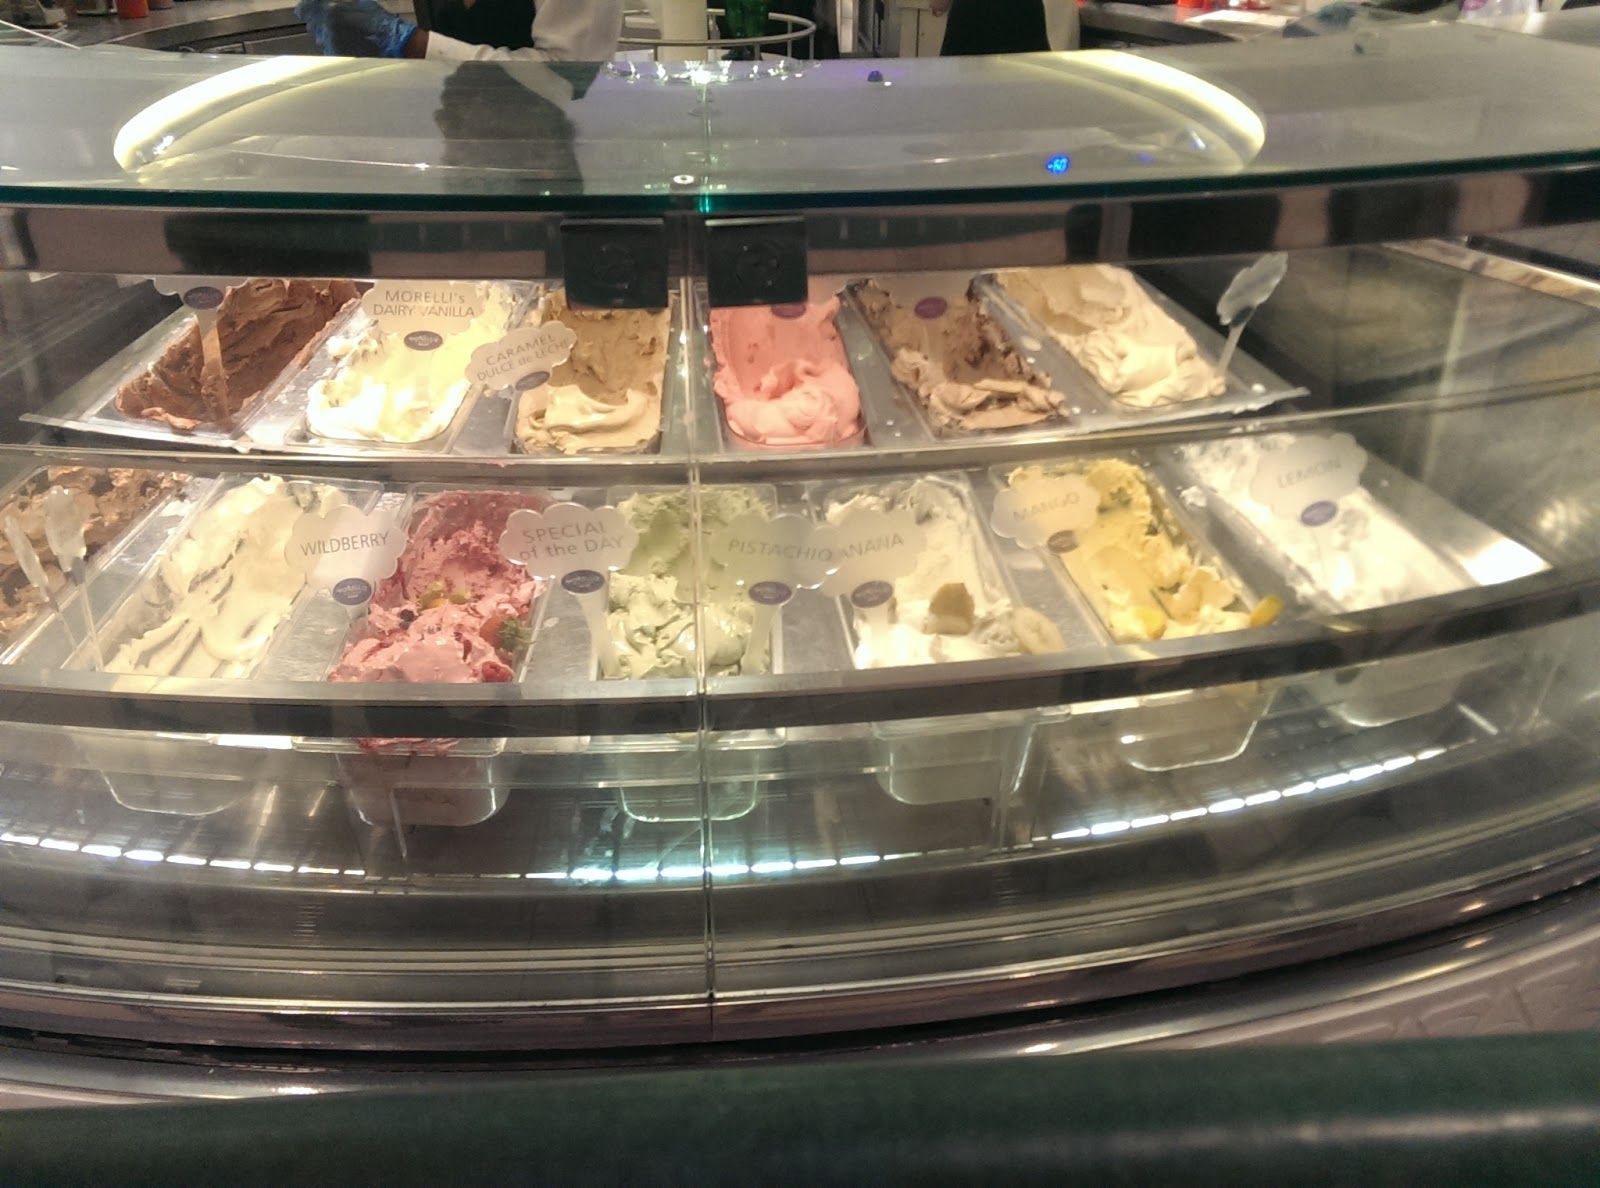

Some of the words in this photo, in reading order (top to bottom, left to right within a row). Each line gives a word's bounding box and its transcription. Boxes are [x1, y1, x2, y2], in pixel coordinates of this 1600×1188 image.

[385, 290, 465, 304] MORELLI's
[373, 304, 415, 316] DAIRY
[420, 305, 475, 318] VANILLA
[486, 334, 556, 366] CARAMEL
[476, 360, 514, 382] DULCE
[300, 531, 389, 556] WILDBERRY
[522, 521, 607, 544] SPECIAL
[842, 532, 905, 558] NANA
[520, 546, 538, 561] of
[546, 542, 577, 558] the
[584, 535, 624, 553] DAY
[728, 537, 833, 562] PISTACHIO
